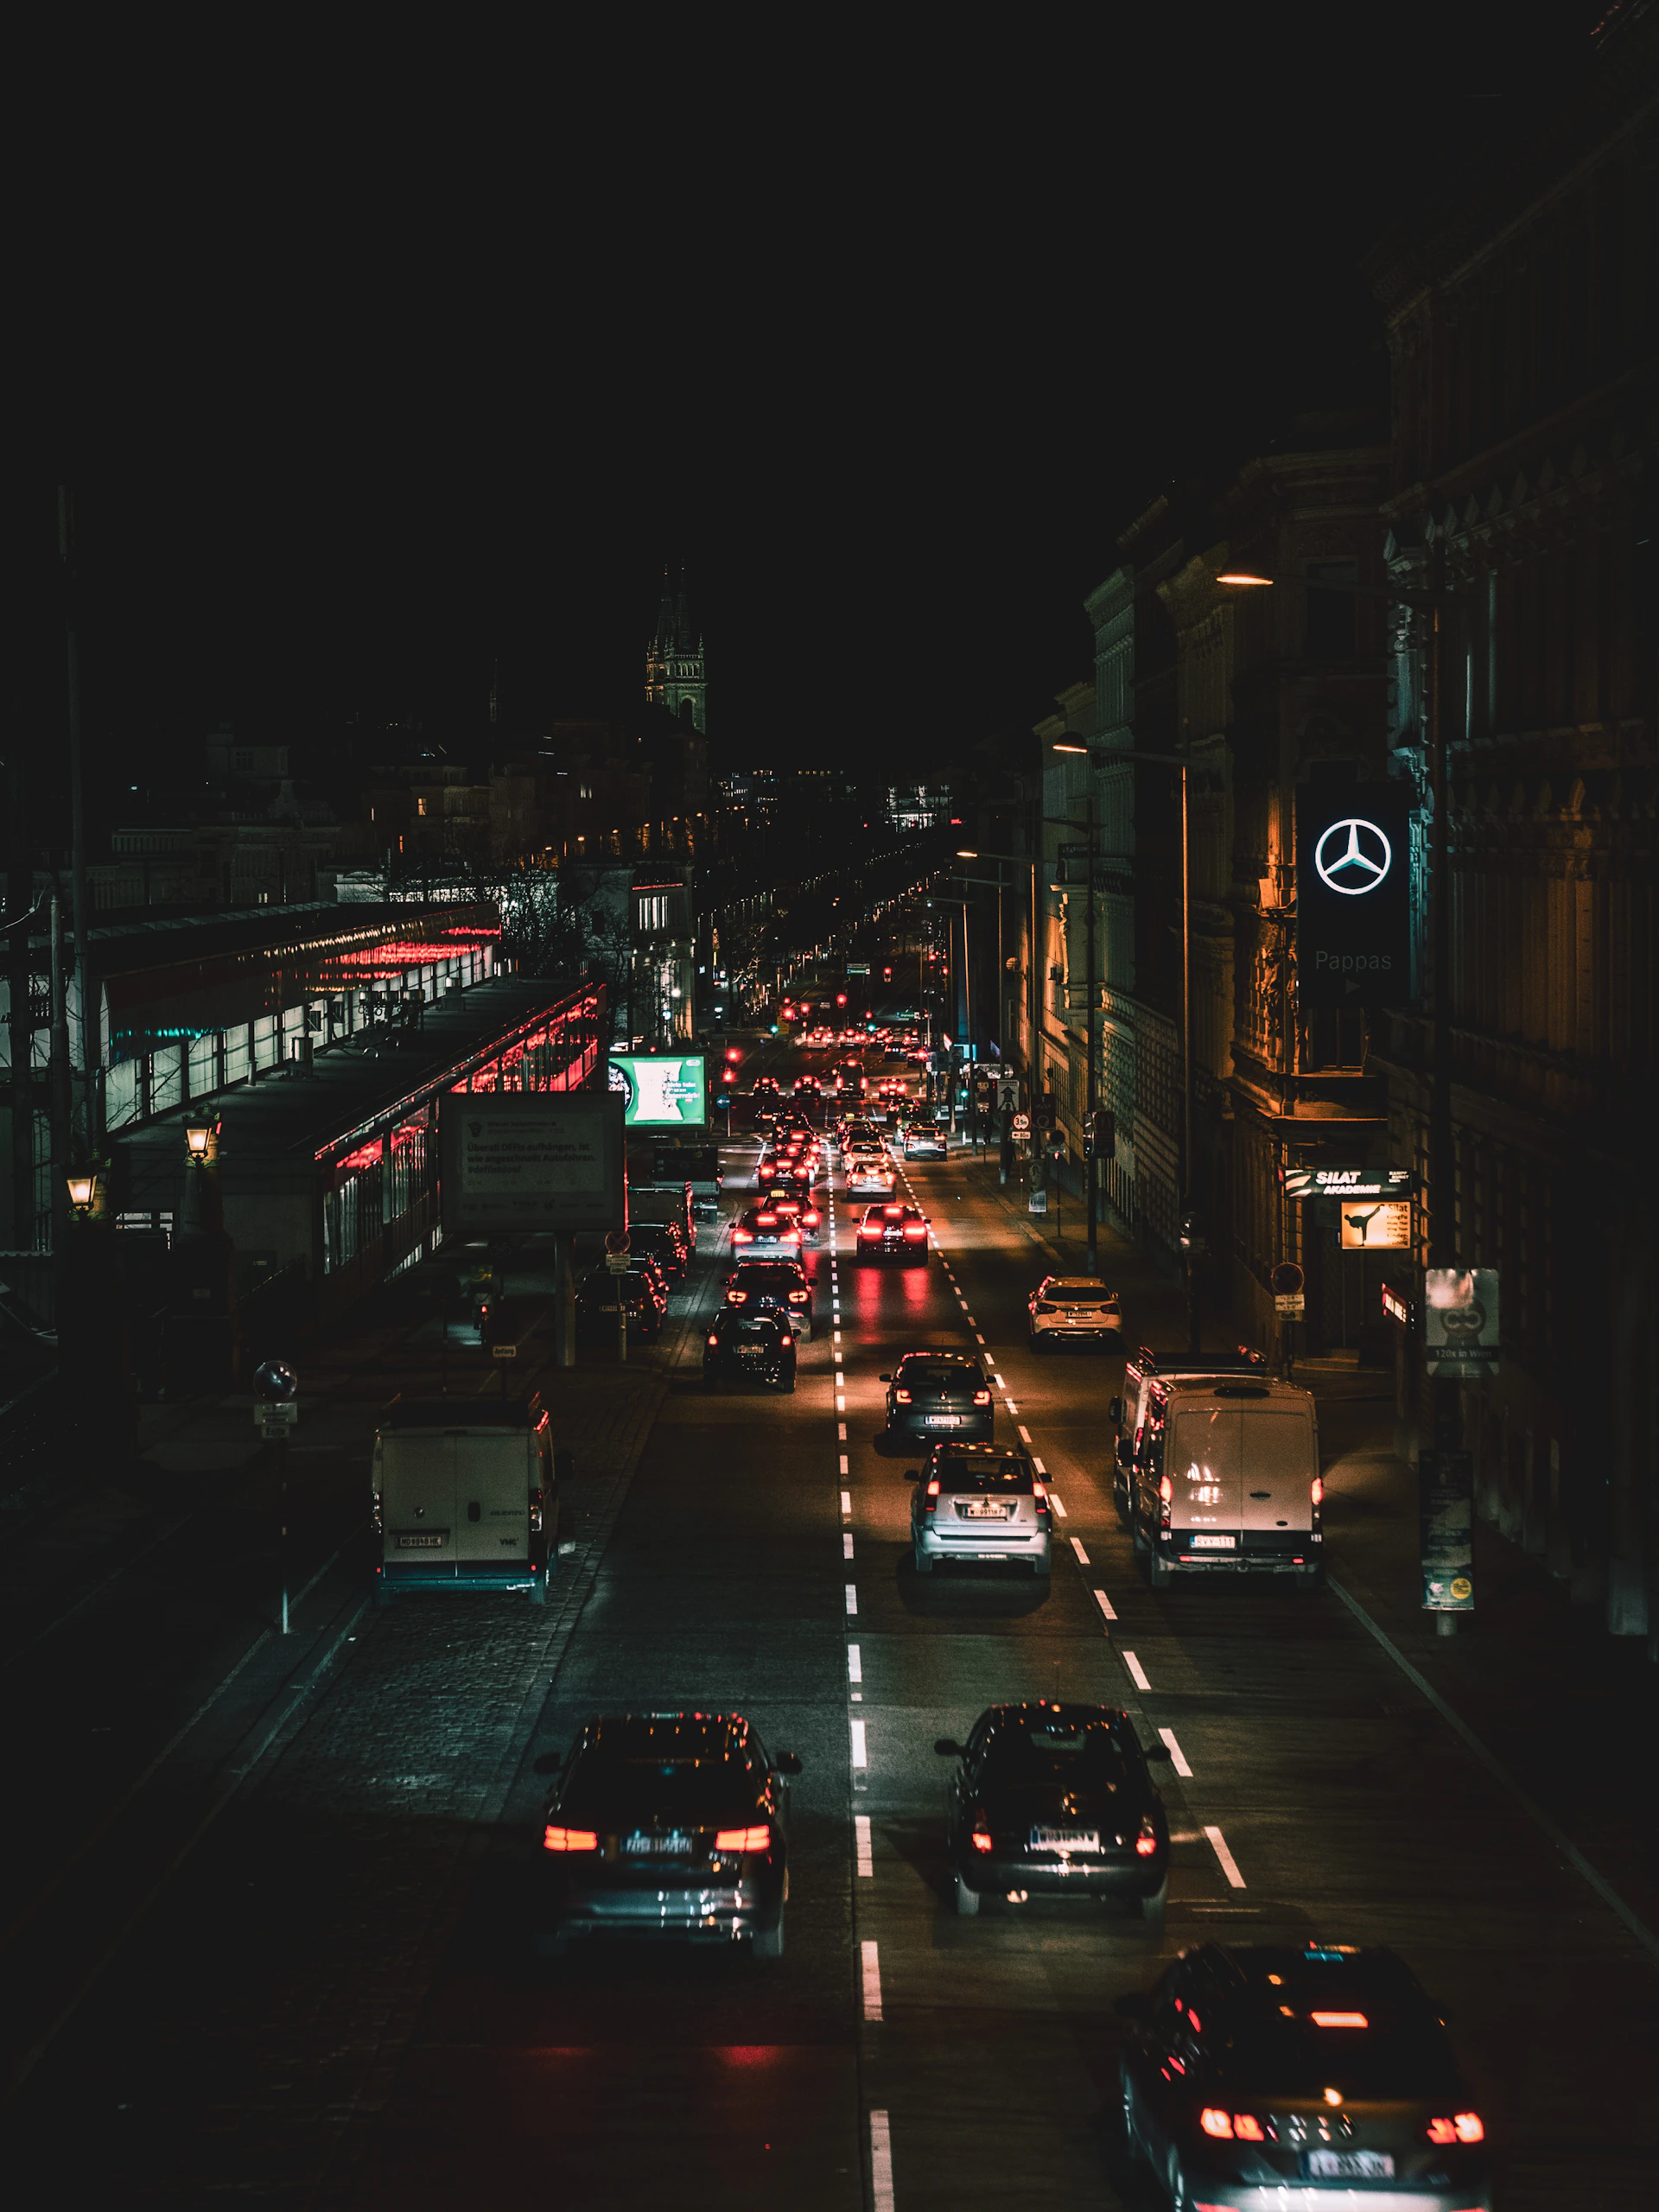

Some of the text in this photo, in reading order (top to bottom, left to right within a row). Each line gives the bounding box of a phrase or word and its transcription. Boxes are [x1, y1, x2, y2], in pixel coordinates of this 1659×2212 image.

[1316, 950, 1392, 973] Pappas
[467, 1141, 499, 1152] Überall
[578, 1142, 591, 1152] ist
[485, 1154, 541, 1165] angeschnallt
[543, 1153, 596, 1163] Autofahren.
[1315, 1171, 1362, 1185] SILAT
[1322, 1185, 1382, 1194] AKADEMIE
[1388, 1204, 1408, 1213] Silat
[1434, 1349, 1457, 1358] 120x
[1458, 1349, 1468, 1358] in
[1196, 1537, 1232, 1546] RVY-111
